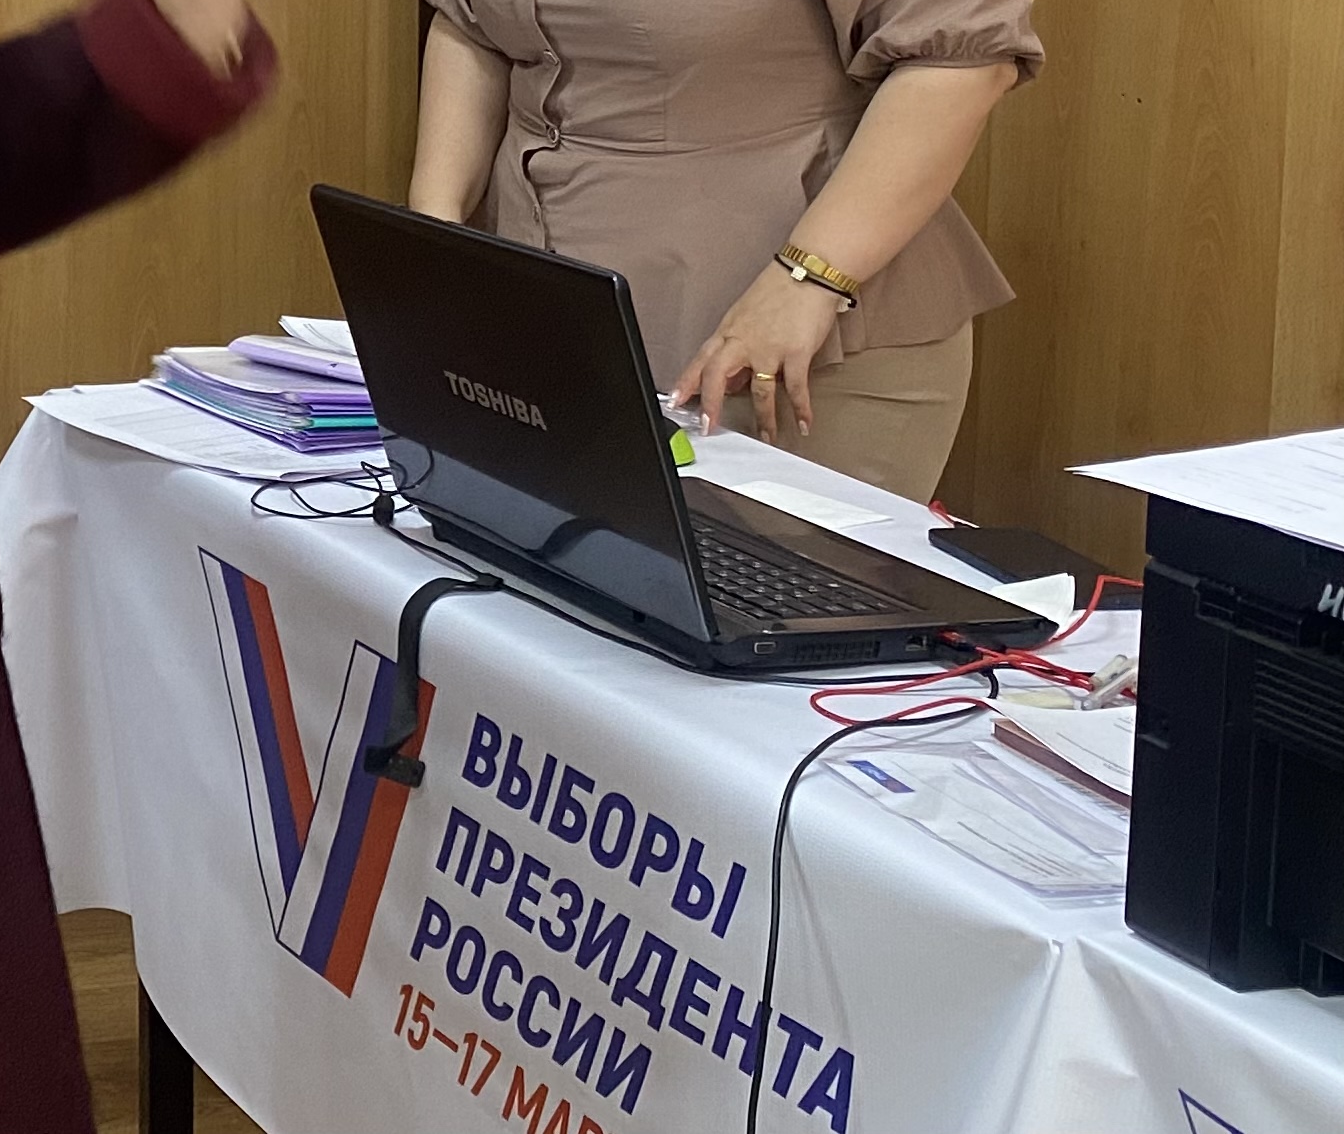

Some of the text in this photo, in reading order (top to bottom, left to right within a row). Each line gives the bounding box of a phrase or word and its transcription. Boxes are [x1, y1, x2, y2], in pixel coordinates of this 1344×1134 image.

[443, 370, 548, 432] TOSHIBA
[461, 712, 747, 939] ВЫБОРЫ
[410, 896, 652, 1116] РОССИИ
[435, 806, 855, 1134] ПРЕЗИДЕНТА
